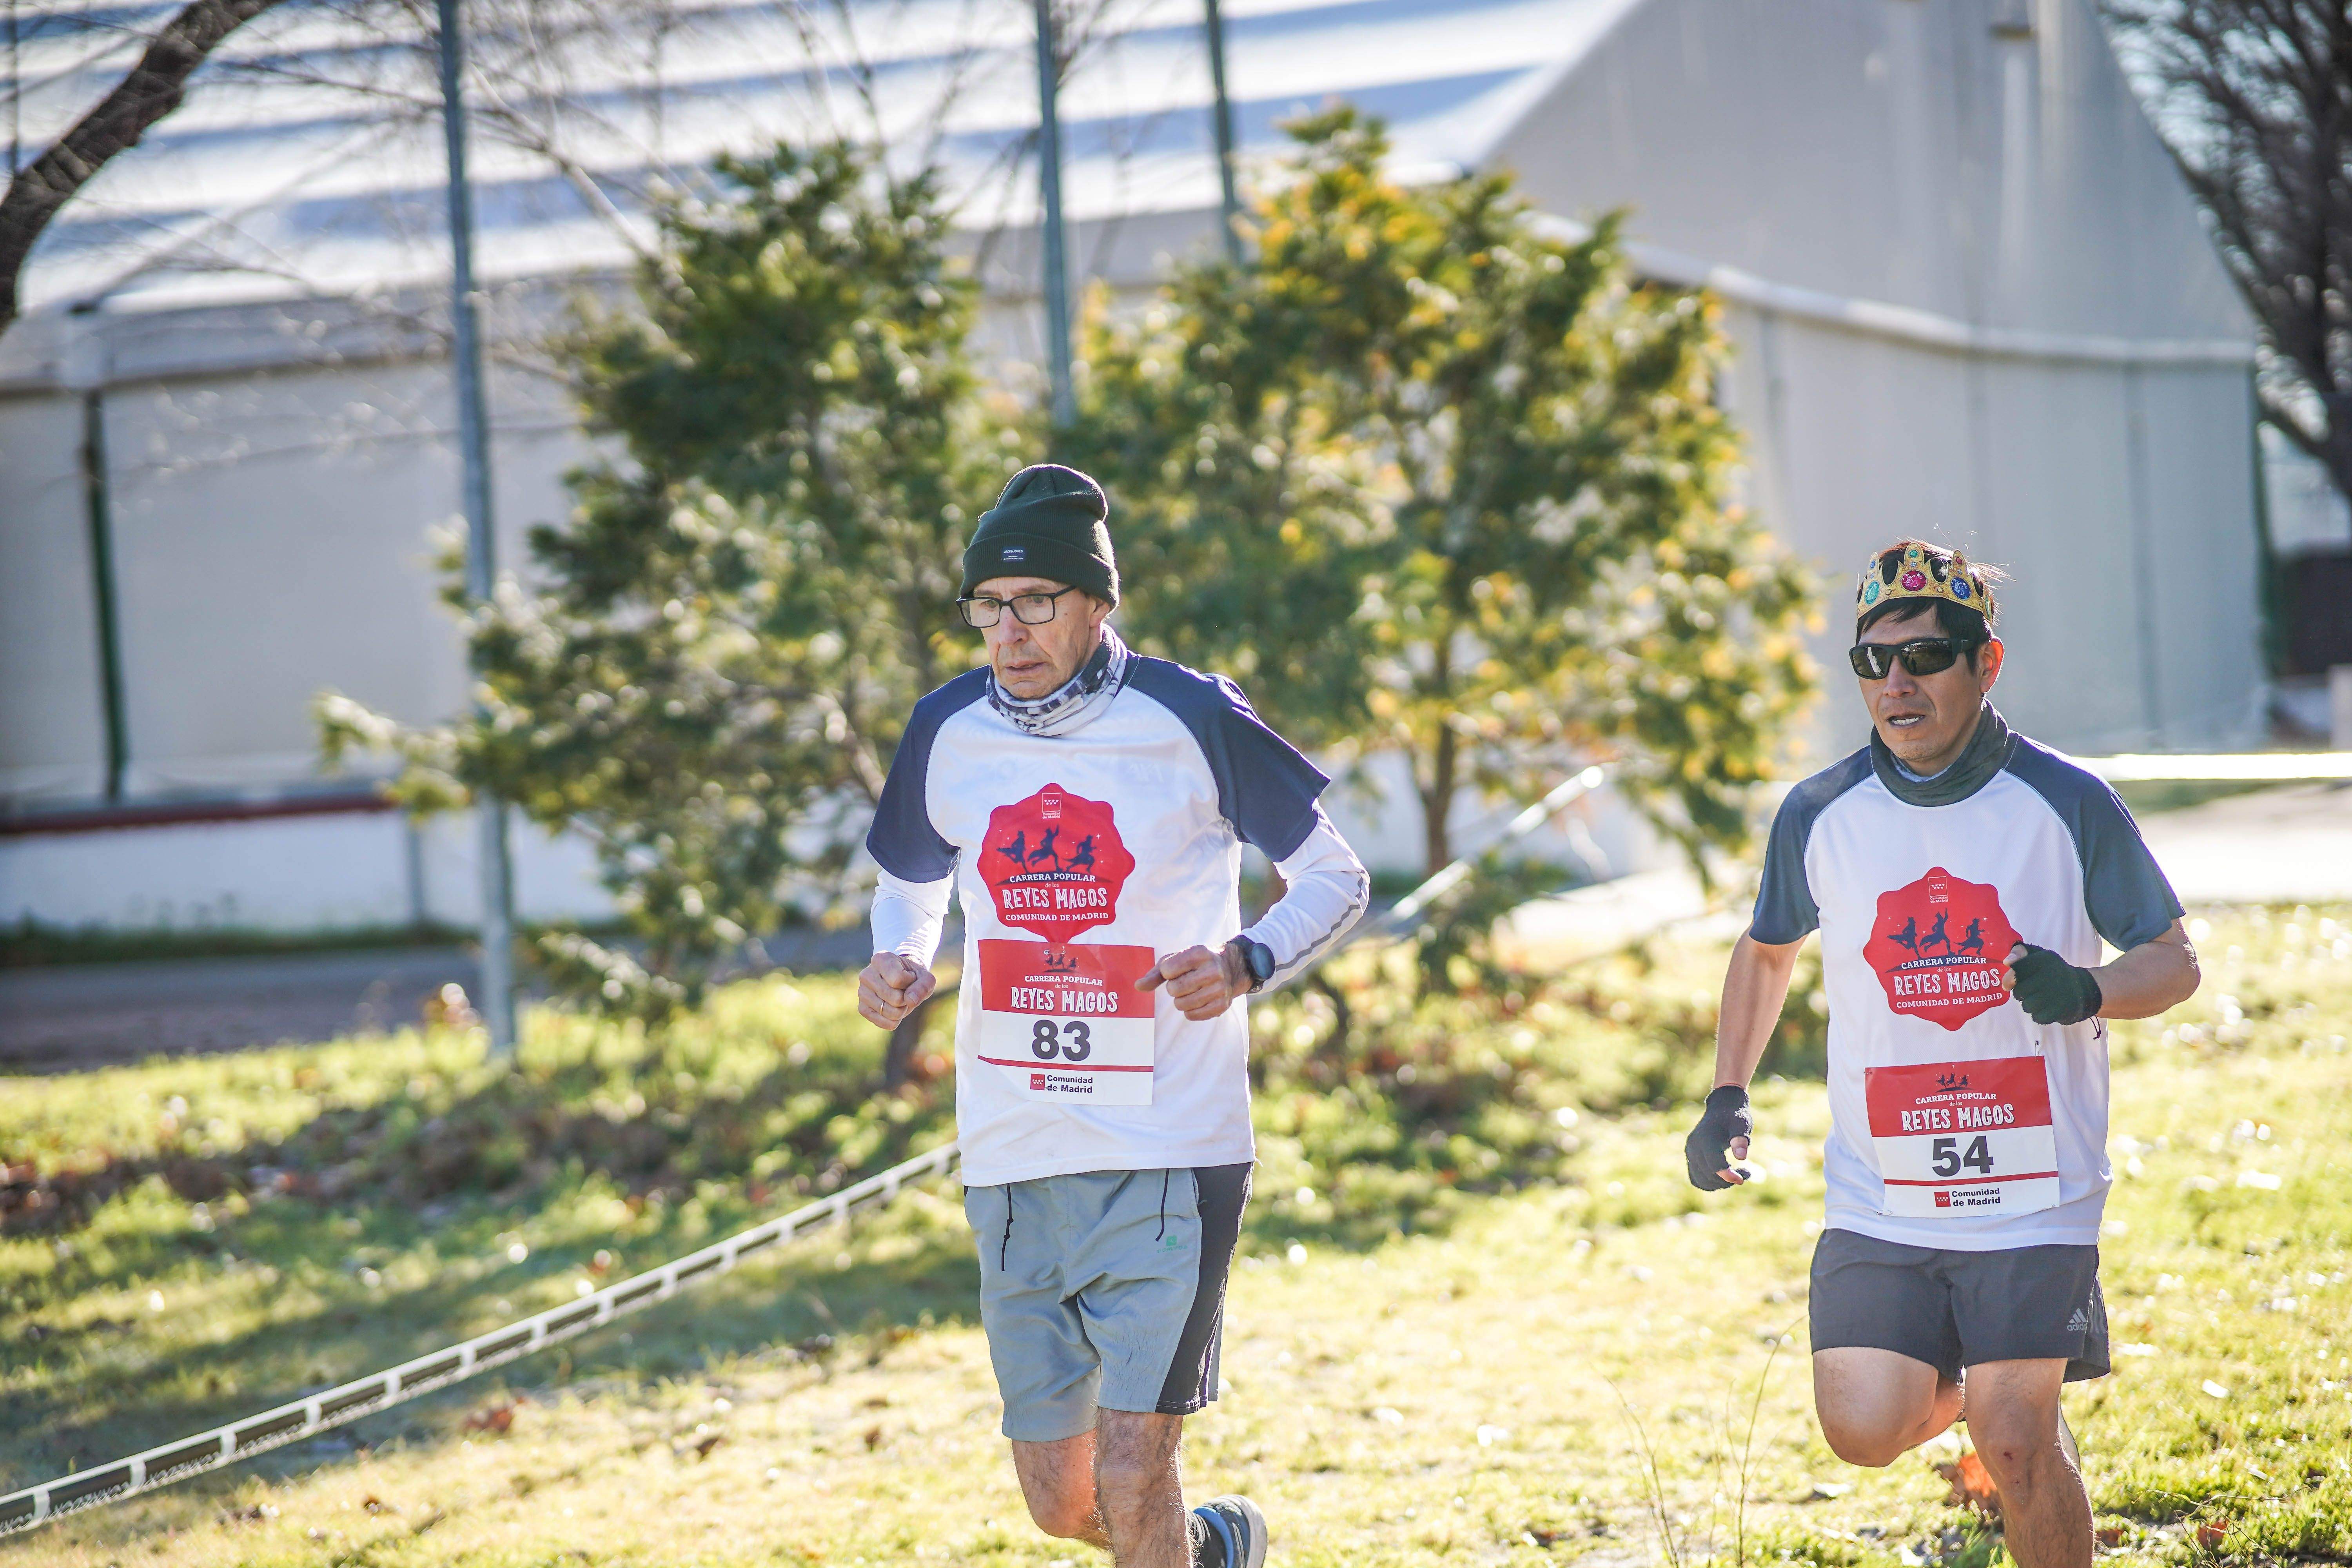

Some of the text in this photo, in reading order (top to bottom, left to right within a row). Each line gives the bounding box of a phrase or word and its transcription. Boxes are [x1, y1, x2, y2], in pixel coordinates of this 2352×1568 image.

[1009, 873, 1095, 882] CARRERA POPULAR
[1002, 887, 1107, 909] REYES MAGOS
[1901, 958, 1943, 969] CARRERA
[1063, 976, 1103, 985] POPULAR
[1893, 968, 2000, 995] REYES MAGOS
[1011, 987, 1118, 1012] REYES MAGOS
[1896, 998, 1949, 1008] COMUNIDAD
[1966, 993, 2002, 1004] MADRID
[1032, 1020, 1091, 1061] 83
[1047, 1075, 1093, 1083] Comunidad
[1915, 1094, 1954, 1104] CARRERA
[1901, 1103, 2014, 1131] REYES MAGOS
[1932, 1136, 1994, 1176] 54
[1951, 1188, 2000, 1197] Comunidad
[1967, 1197, 2000, 1205] Madrid
[2067, 1323, 2087, 1331] adida
